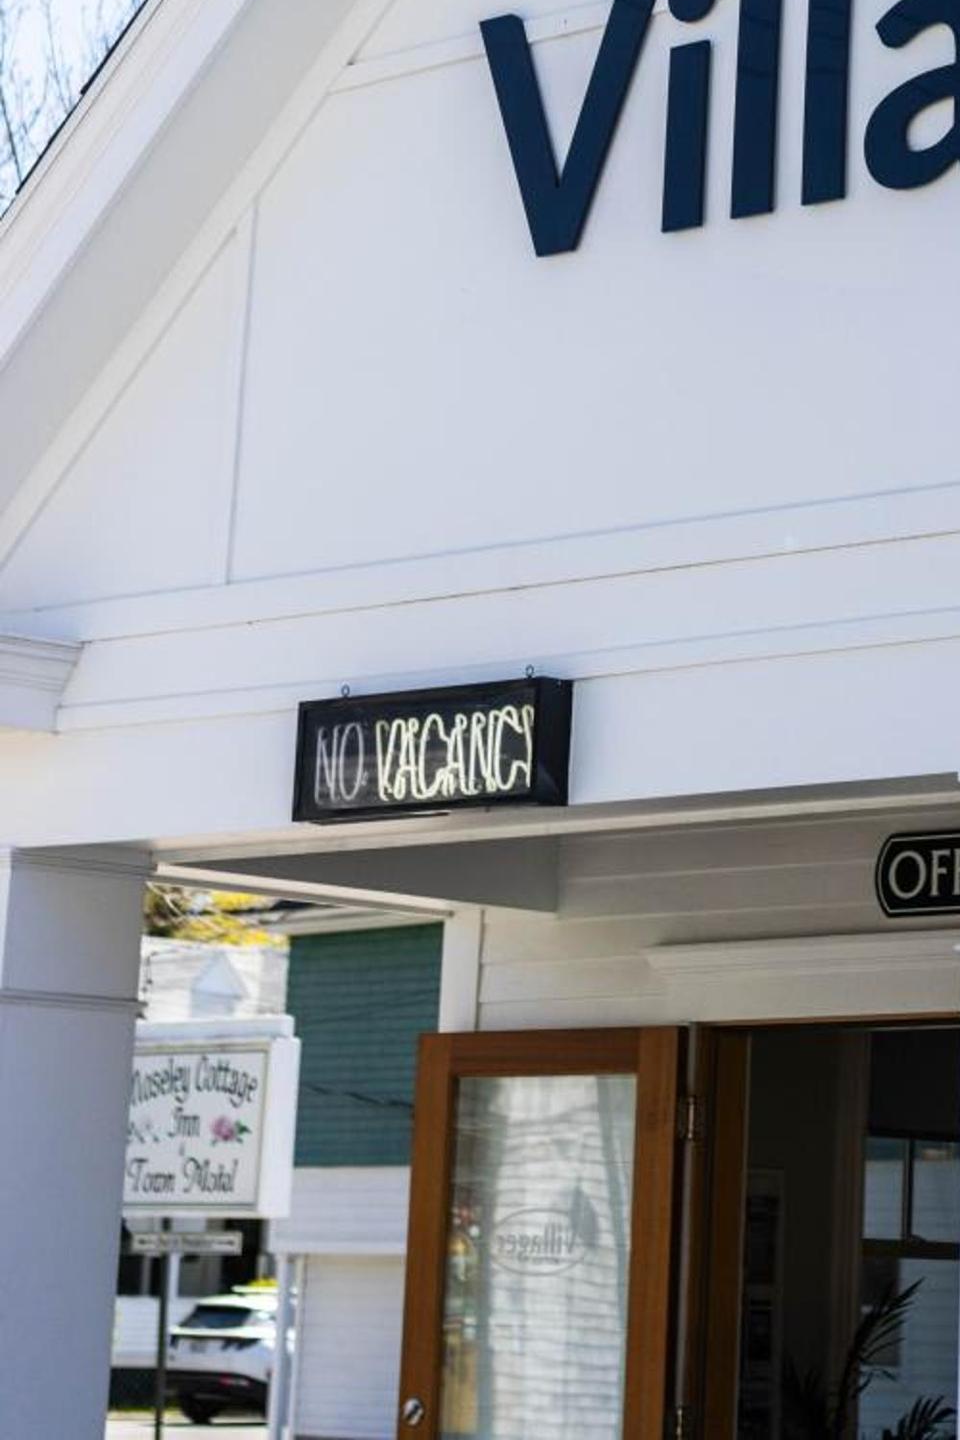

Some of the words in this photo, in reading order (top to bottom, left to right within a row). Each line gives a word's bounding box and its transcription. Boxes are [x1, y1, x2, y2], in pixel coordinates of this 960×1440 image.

[314, 722, 365, 804] NO
[375, 705, 535, 801] VACANCY
[195, 1054, 258, 1109] Cottage
[167, 1106, 201, 1139] Inn
[126, 1157, 176, 1193] Town
